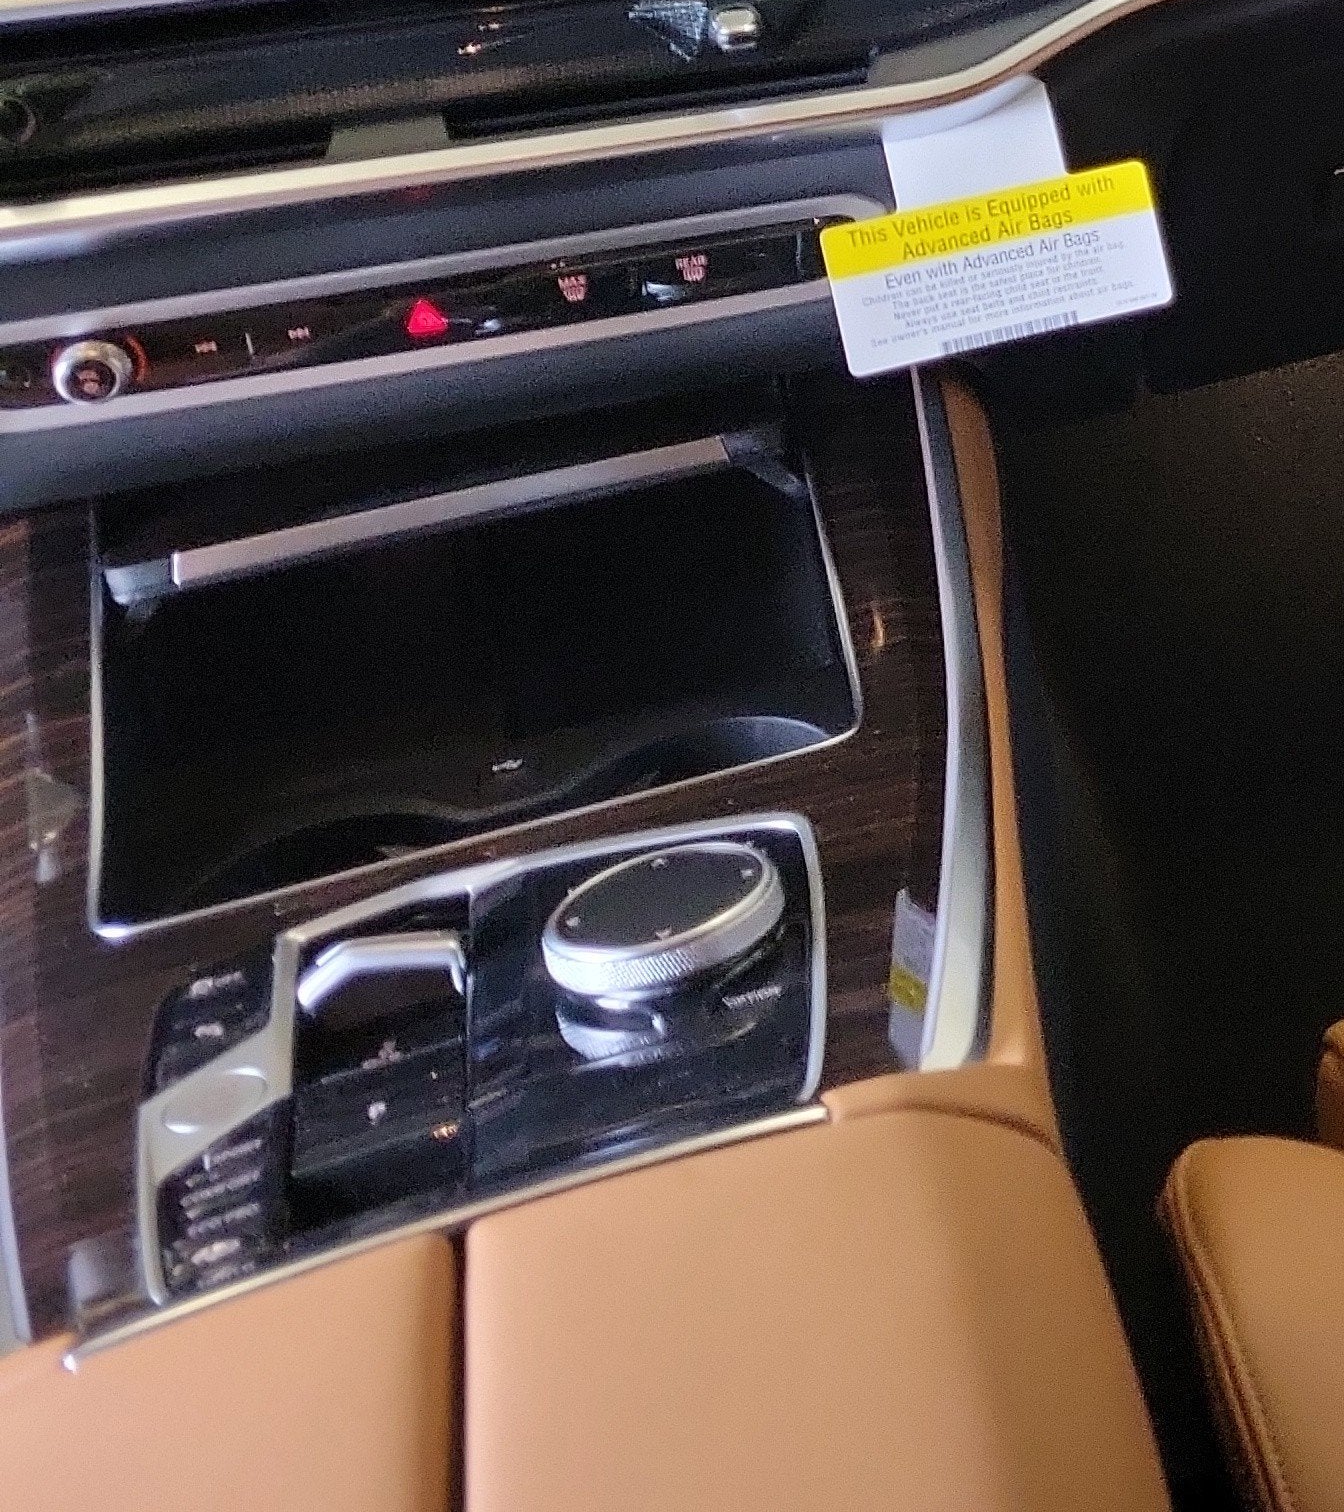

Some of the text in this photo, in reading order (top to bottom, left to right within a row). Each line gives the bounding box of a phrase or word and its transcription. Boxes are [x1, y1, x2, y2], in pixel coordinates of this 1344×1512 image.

[847, 176, 1115, 248] This Vehicle is Equipped with
[903, 208, 1074, 260] Advanced Air Bags
[861, 291, 902, 306] Children
[939, 276, 964, 288] killed
[980, 263, 1023, 279] seriously
[1025, 254, 1057, 268] injured
[1074, 248, 1089, 256] the
[885, 229, 1100, 289] Even with Advanced Air Bags
[892, 299, 909, 309] The
[912, 293, 934, 304] back
[937, 288, 957, 299] seat
[970, 282, 985, 291] the
[988, 274, 1017, 287] safest
[1019, 268, 1043, 280] place
[893, 308, 921, 320] Never
[923, 304, 939, 315] put
[950, 289, 1002, 307] rear-facing
[1004, 283, 1027, 294] child
[1030, 278, 1049, 288] seat
[905, 315, 938, 327] Always
[960, 305, 980, 315] seat
[982, 299, 1005, 310] belts
[1008, 294, 1024, 304] and
[1027, 288, 1050, 300] child
[871, 337, 888, 347] See
[891, 327, 928, 342] owner's
[931, 319, 965, 332] manual
[984, 308, 1009, 320] more
[1011, 295, 1065, 314] information
[1068, 288, 1093, 301] about
